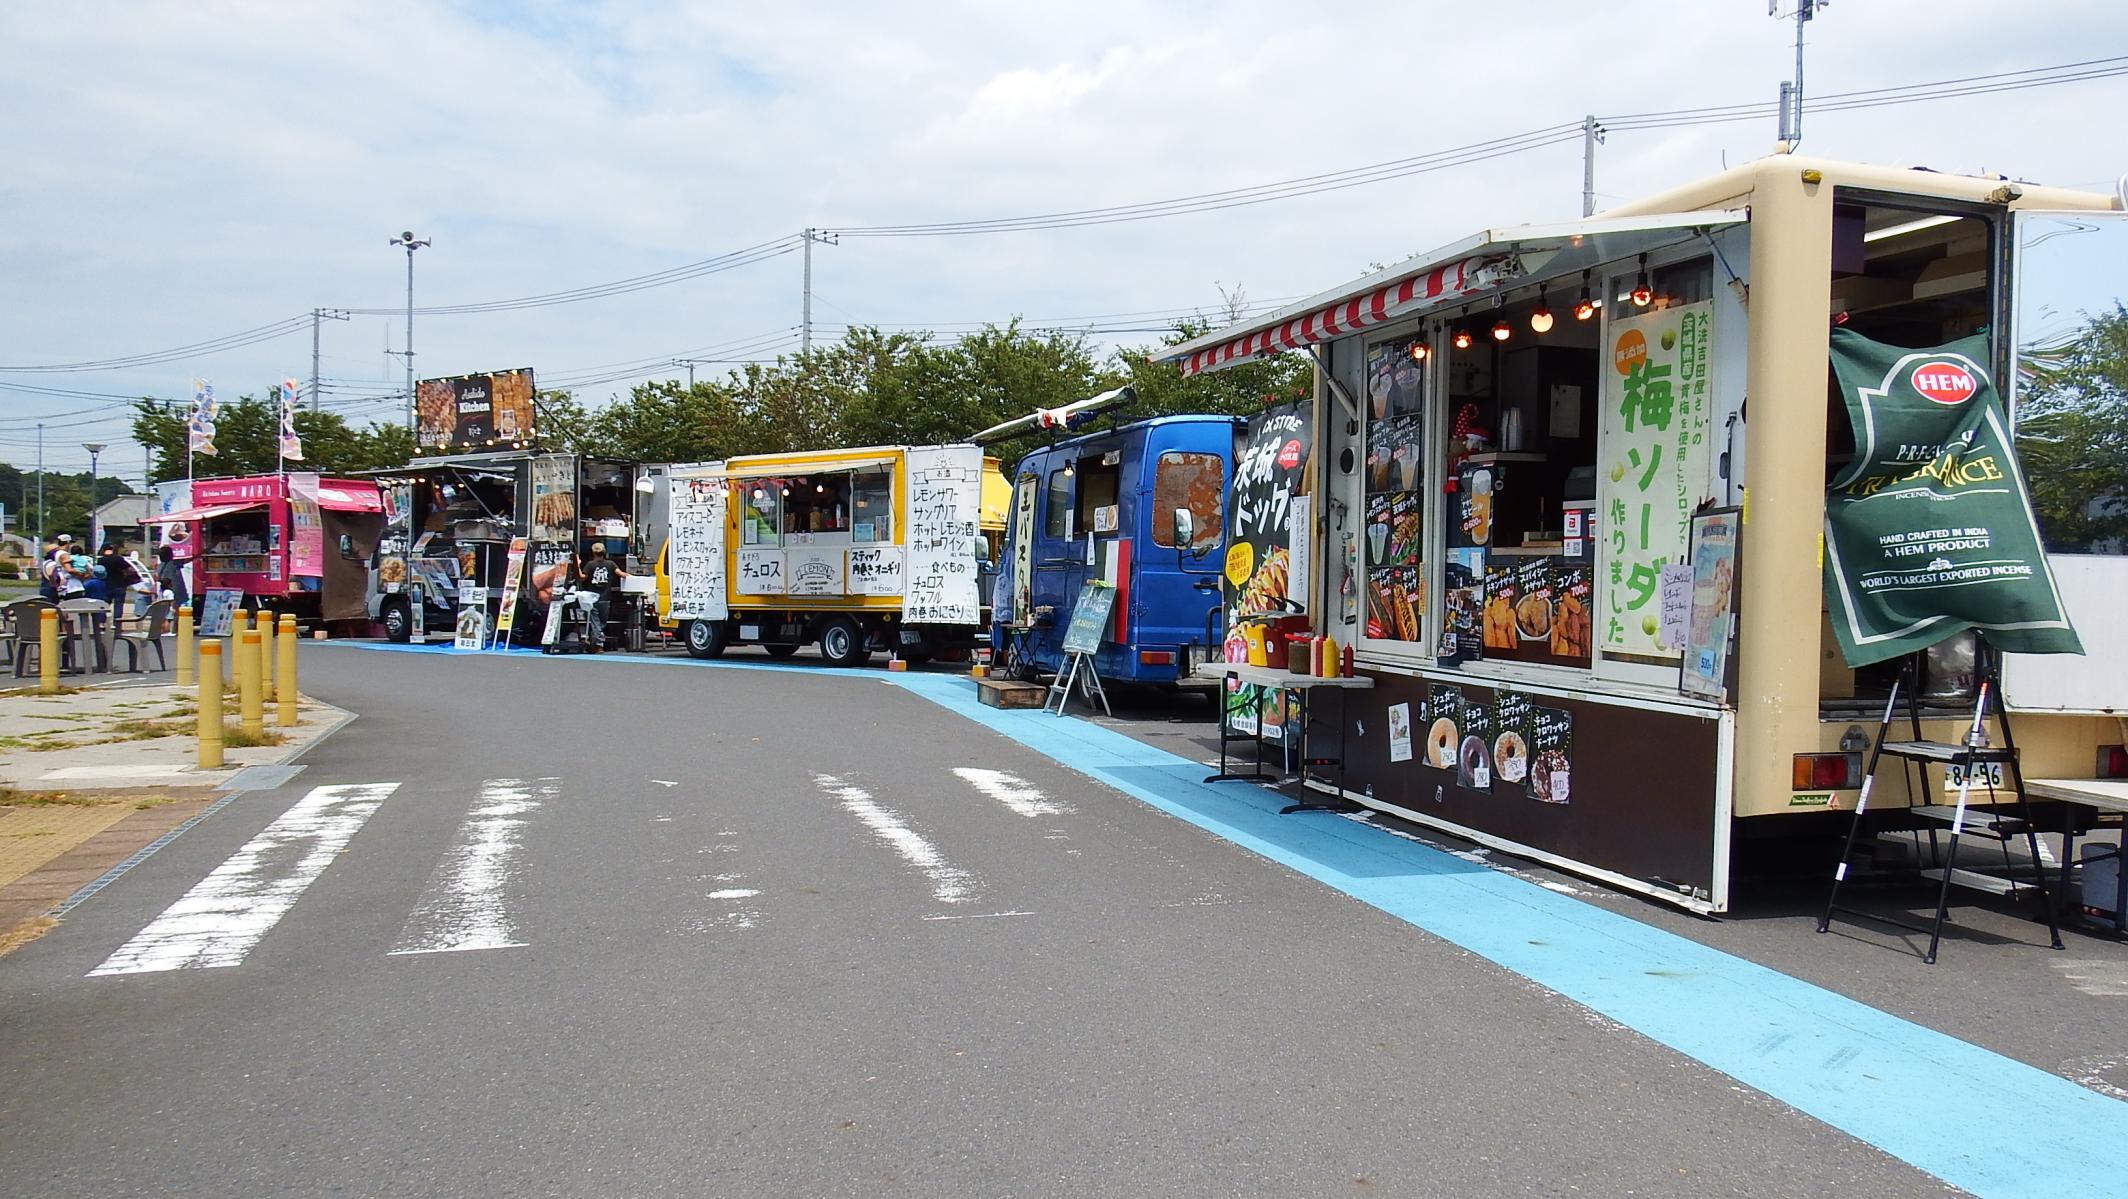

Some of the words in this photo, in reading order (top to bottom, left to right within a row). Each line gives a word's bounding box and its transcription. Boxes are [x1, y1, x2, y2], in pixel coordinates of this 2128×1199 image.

[1691, 311, 1709, 446] 大洗吉田屋さんの
[1917, 374, 1972, 392] HEM
[459, 401, 490, 413] Kitchen
[1676, 382, 1691, 546] 青梅を使用したシロップで
[1619, 358, 1675, 611] 梅ソーダ
[913, 488, 959, 502] レモンサワー
[913, 504, 957, 520] サングリア
[676, 526, 705, 539] レモネード
[913, 521, 974, 537] ホットレモン酒
[1880, 535, 1905, 545] HAND
[1907, 529, 1950, 541] CRAFTED
[1952, 528, 1962, 537] IN
[1964, 527, 1989, 537] INDIA
[676, 541, 718, 554] レモンスカッシュ
[1884, 549, 1893, 558] A
[1895, 544, 1925, 556] HEM
[1928, 538, 1991, 553] PRODUCT
[676, 556, 709, 569] クラフトコーラ
[851, 549, 881, 562] スティック
[742, 561, 781, 578] チュロス
[931, 561, 965, 574] 食べもの
[1520, 567, 1548, 583] スパイシー
[1608, 498, 1626, 644] 作りました
[913, 575, 944, 588] チュロス
[1524, 577, 1546, 593] ナゲット
[1558, 569, 1582, 588] コンボ
[1860, 576, 1900, 589] WORLD'S
[1900, 573, 1939, 585] LARGEST
[1939, 567, 1991, 582] EXPORTED
[1992, 566, 2033, 576] INCENSE
[911, 591, 942, 604] ワッフル
[1433, 690, 1455, 705] シュガー
[1499, 694, 1521, 708] シュガー
[1434, 702, 1455, 717] ドーナツ
[1465, 707, 1483, 720] チョコ
[1499, 703, 1531, 719] クロワッサン
[1466, 718, 1489, 733] ドーナツ
[1499, 715, 1521, 729] ドーナツ
[1534, 714, 1552, 727] チョコ
[1535, 720, 1569, 737] クロワッサン
[1535, 734, 1559, 749] ドーナツ
[1952, 764, 2001, 787] 8-56
